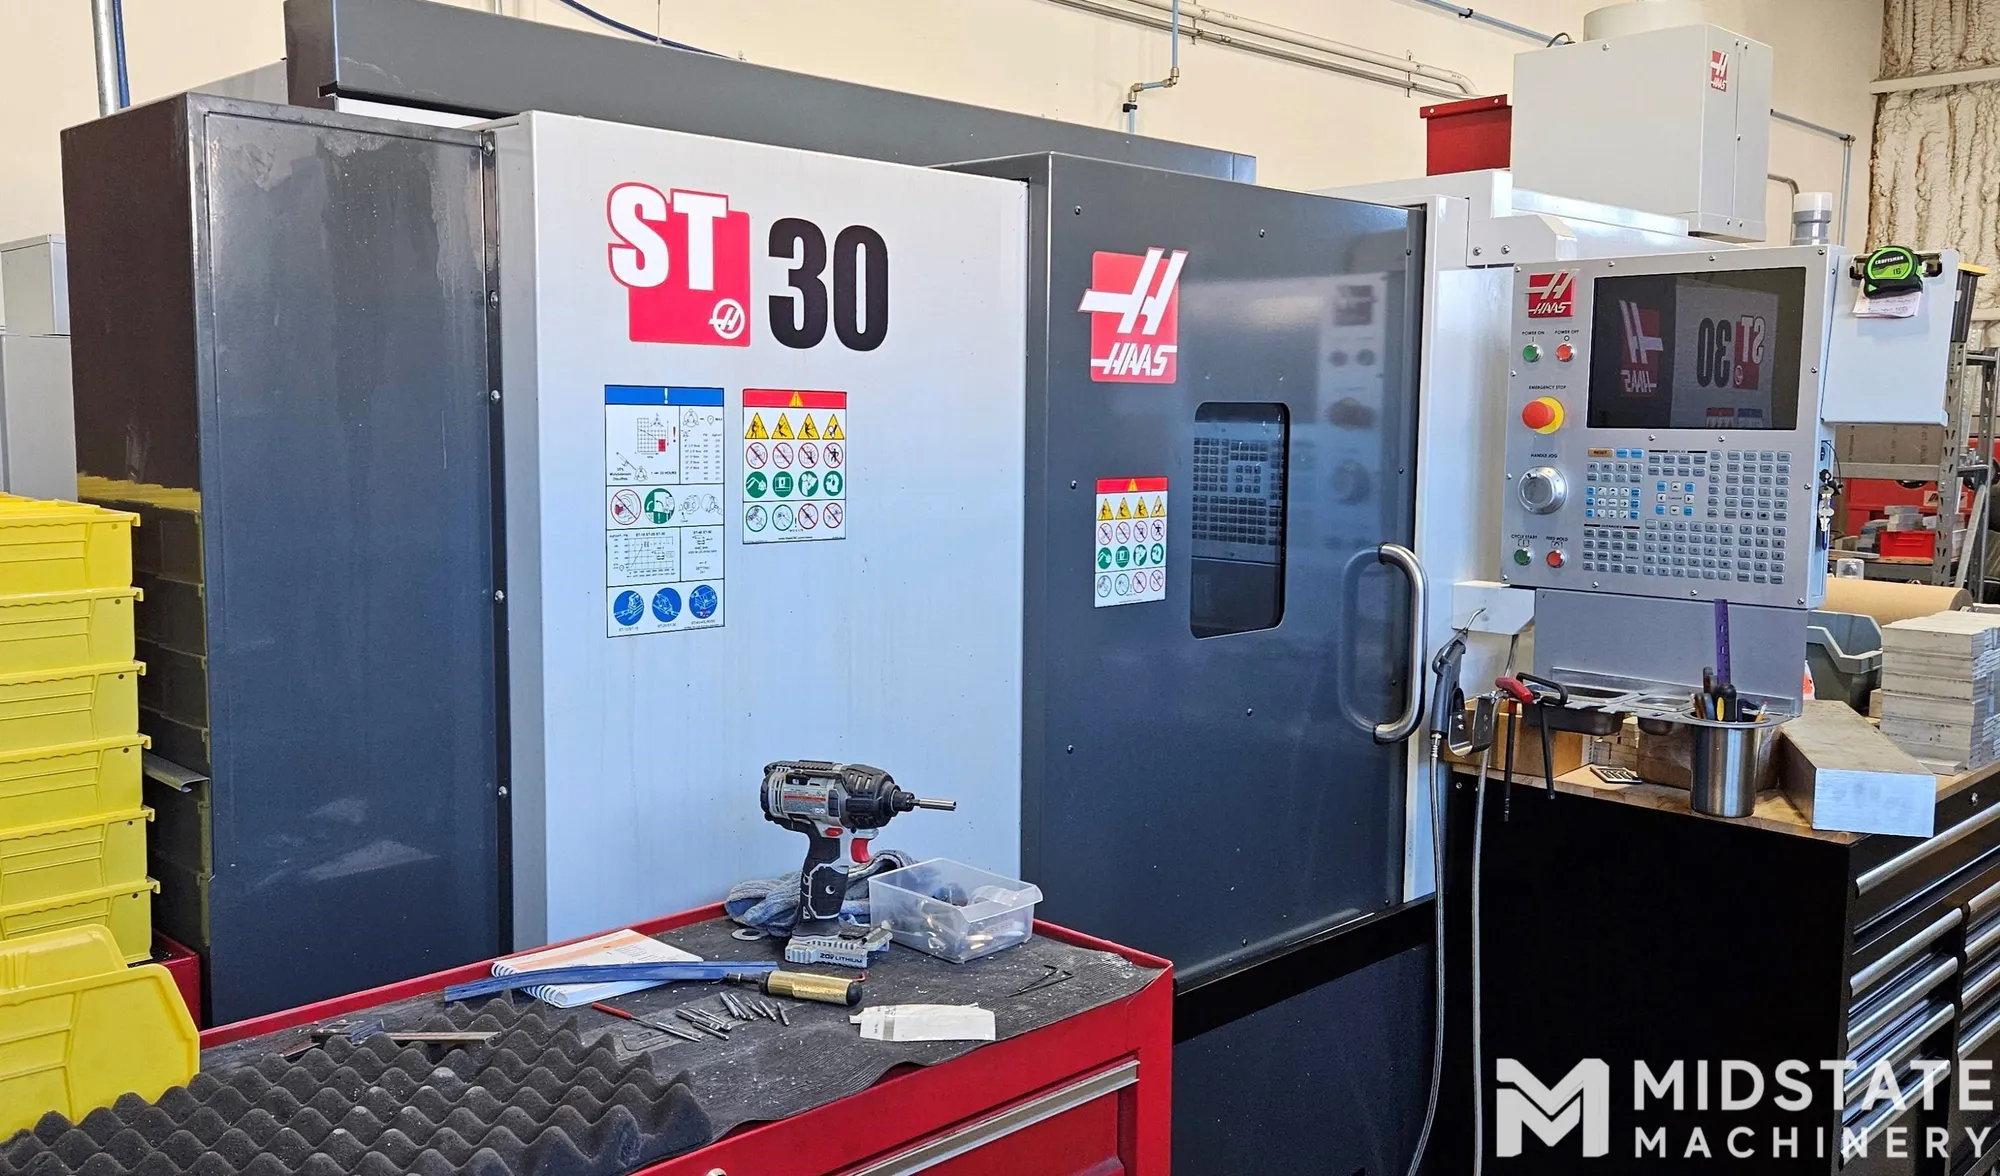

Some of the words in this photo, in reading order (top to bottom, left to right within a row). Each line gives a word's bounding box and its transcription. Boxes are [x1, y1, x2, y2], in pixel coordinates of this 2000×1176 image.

[607, 182, 728, 291] ST
[768, 217, 889, 351] 30
[1874, 256, 1904, 265] CRAFTSMAN
[1528, 302, 1572, 315] HAAS
[1090, 342, 1178, 377] HAAS
[835, 955, 862, 964] LITHIUM
